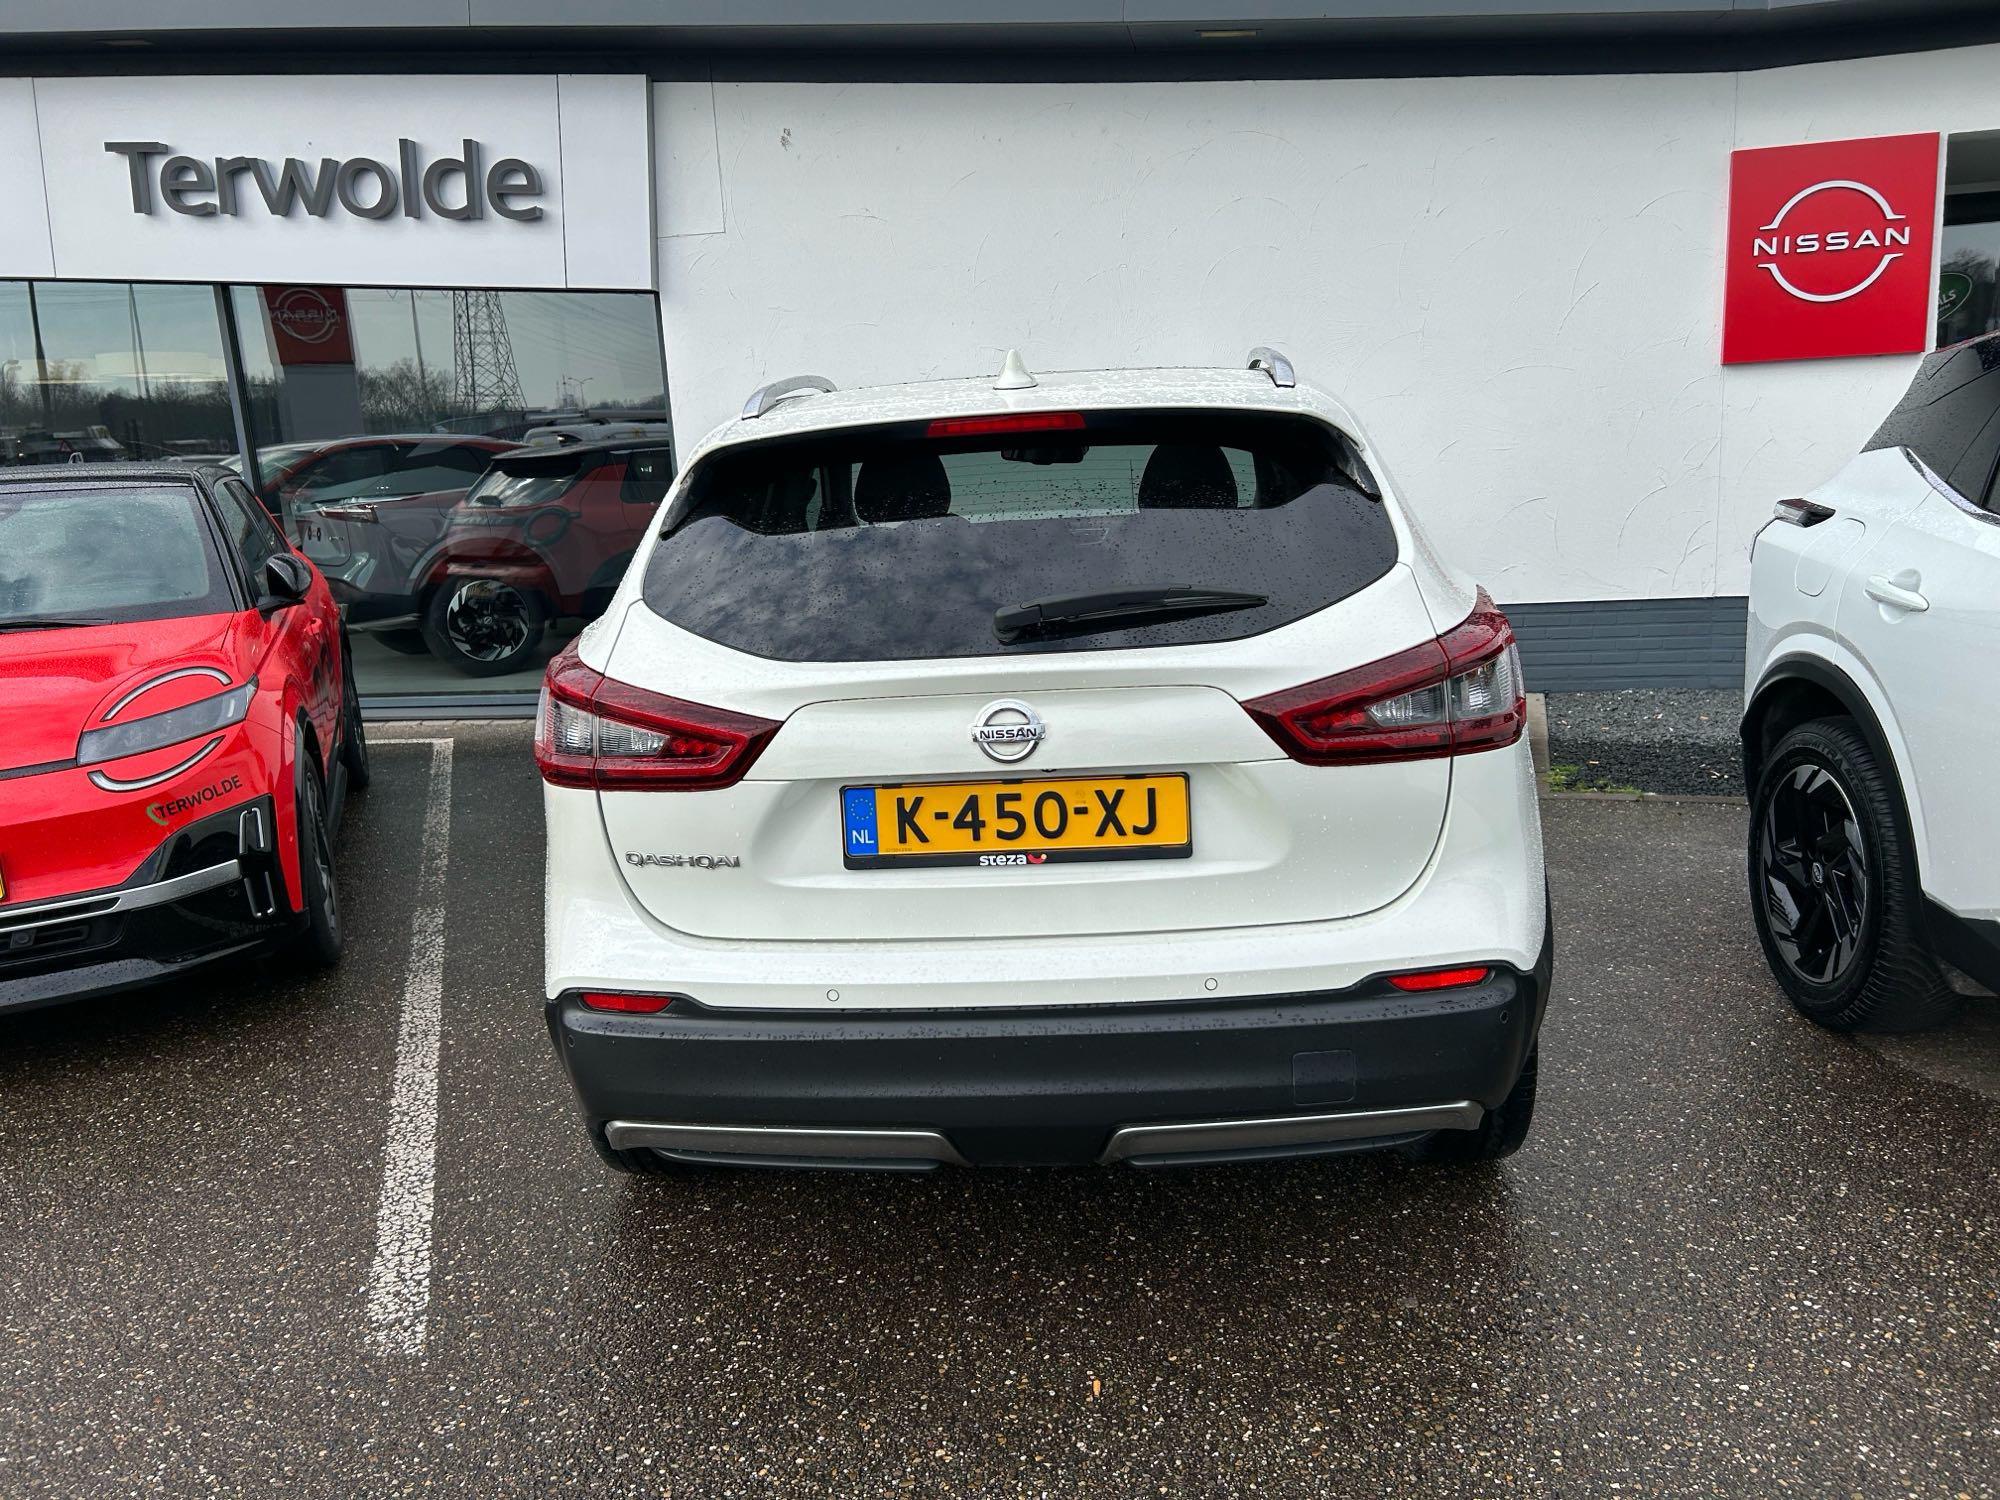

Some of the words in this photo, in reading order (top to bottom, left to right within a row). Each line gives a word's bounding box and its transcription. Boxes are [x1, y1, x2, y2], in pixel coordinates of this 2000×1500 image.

[104, 138, 543, 220] Terwolde
[1753, 226, 1911, 256] NISSAN
[979, 727, 1037, 740] NISSAN
[154, 775, 243, 818] TERWOLDE
[896, 787, 1158, 844] K-450-XJ
[852, 830, 875, 845] NL
[625, 850, 741, 870] QASHQAI
[979, 853, 1028, 867] steza
